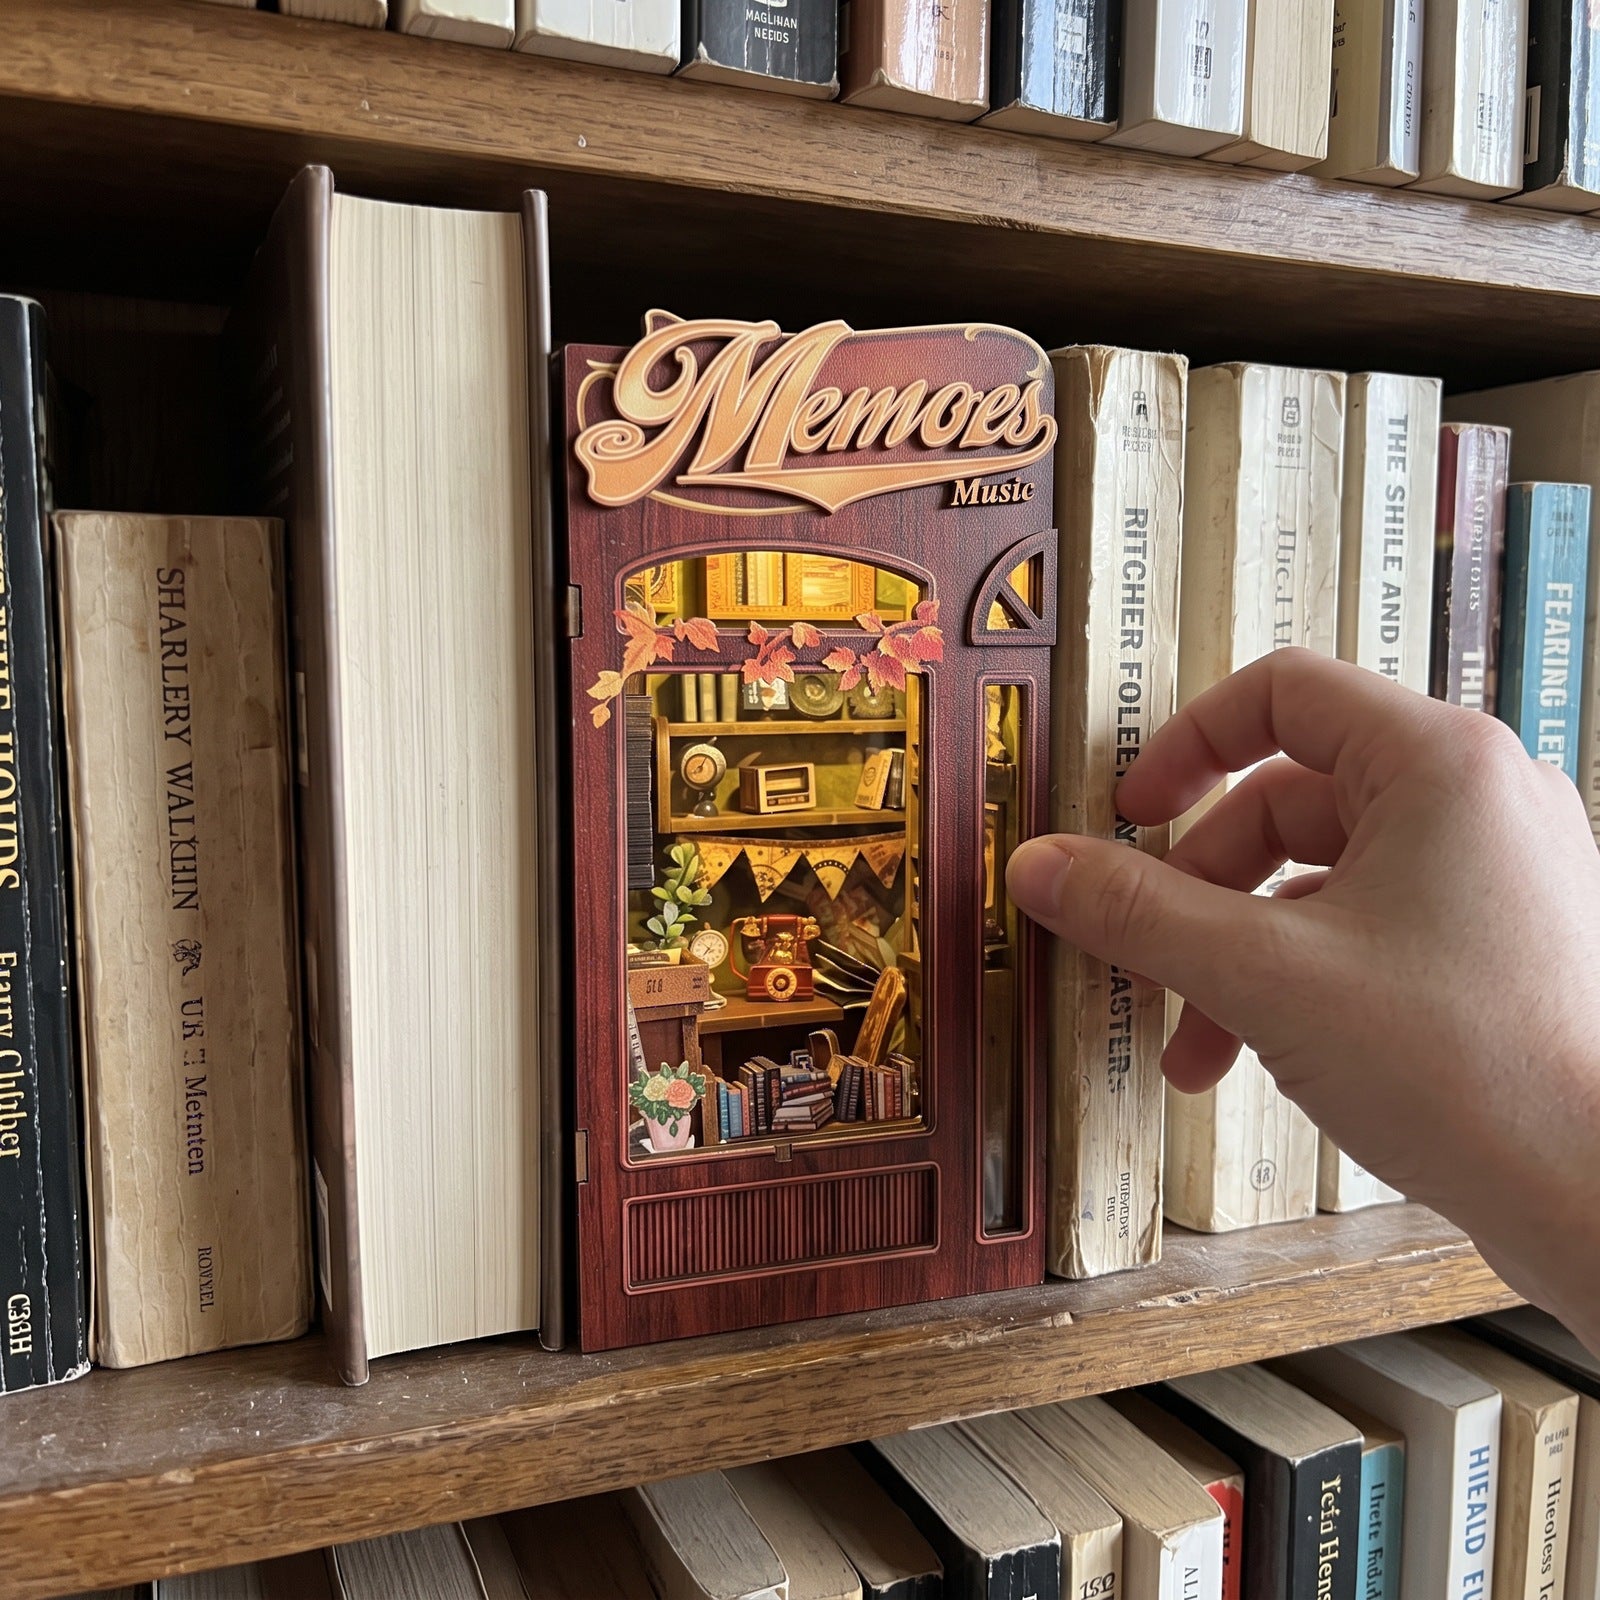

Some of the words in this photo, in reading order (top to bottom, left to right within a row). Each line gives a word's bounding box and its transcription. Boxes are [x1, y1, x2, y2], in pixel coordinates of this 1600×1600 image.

[1388, 414, 1409, 472] THE
[950, 476, 1036, 507] Music
[1383, 485, 1405, 571] SHILE
[1119, 507, 1149, 650] RITCHER
[1381, 581, 1403, 645] AND
[156, 567, 192, 748] SHARLERY
[1379, 657, 1399, 684] H
[1540, 581, 1574, 709] FEARING
[1464, 1444, 1490, 1556] HIEALD
